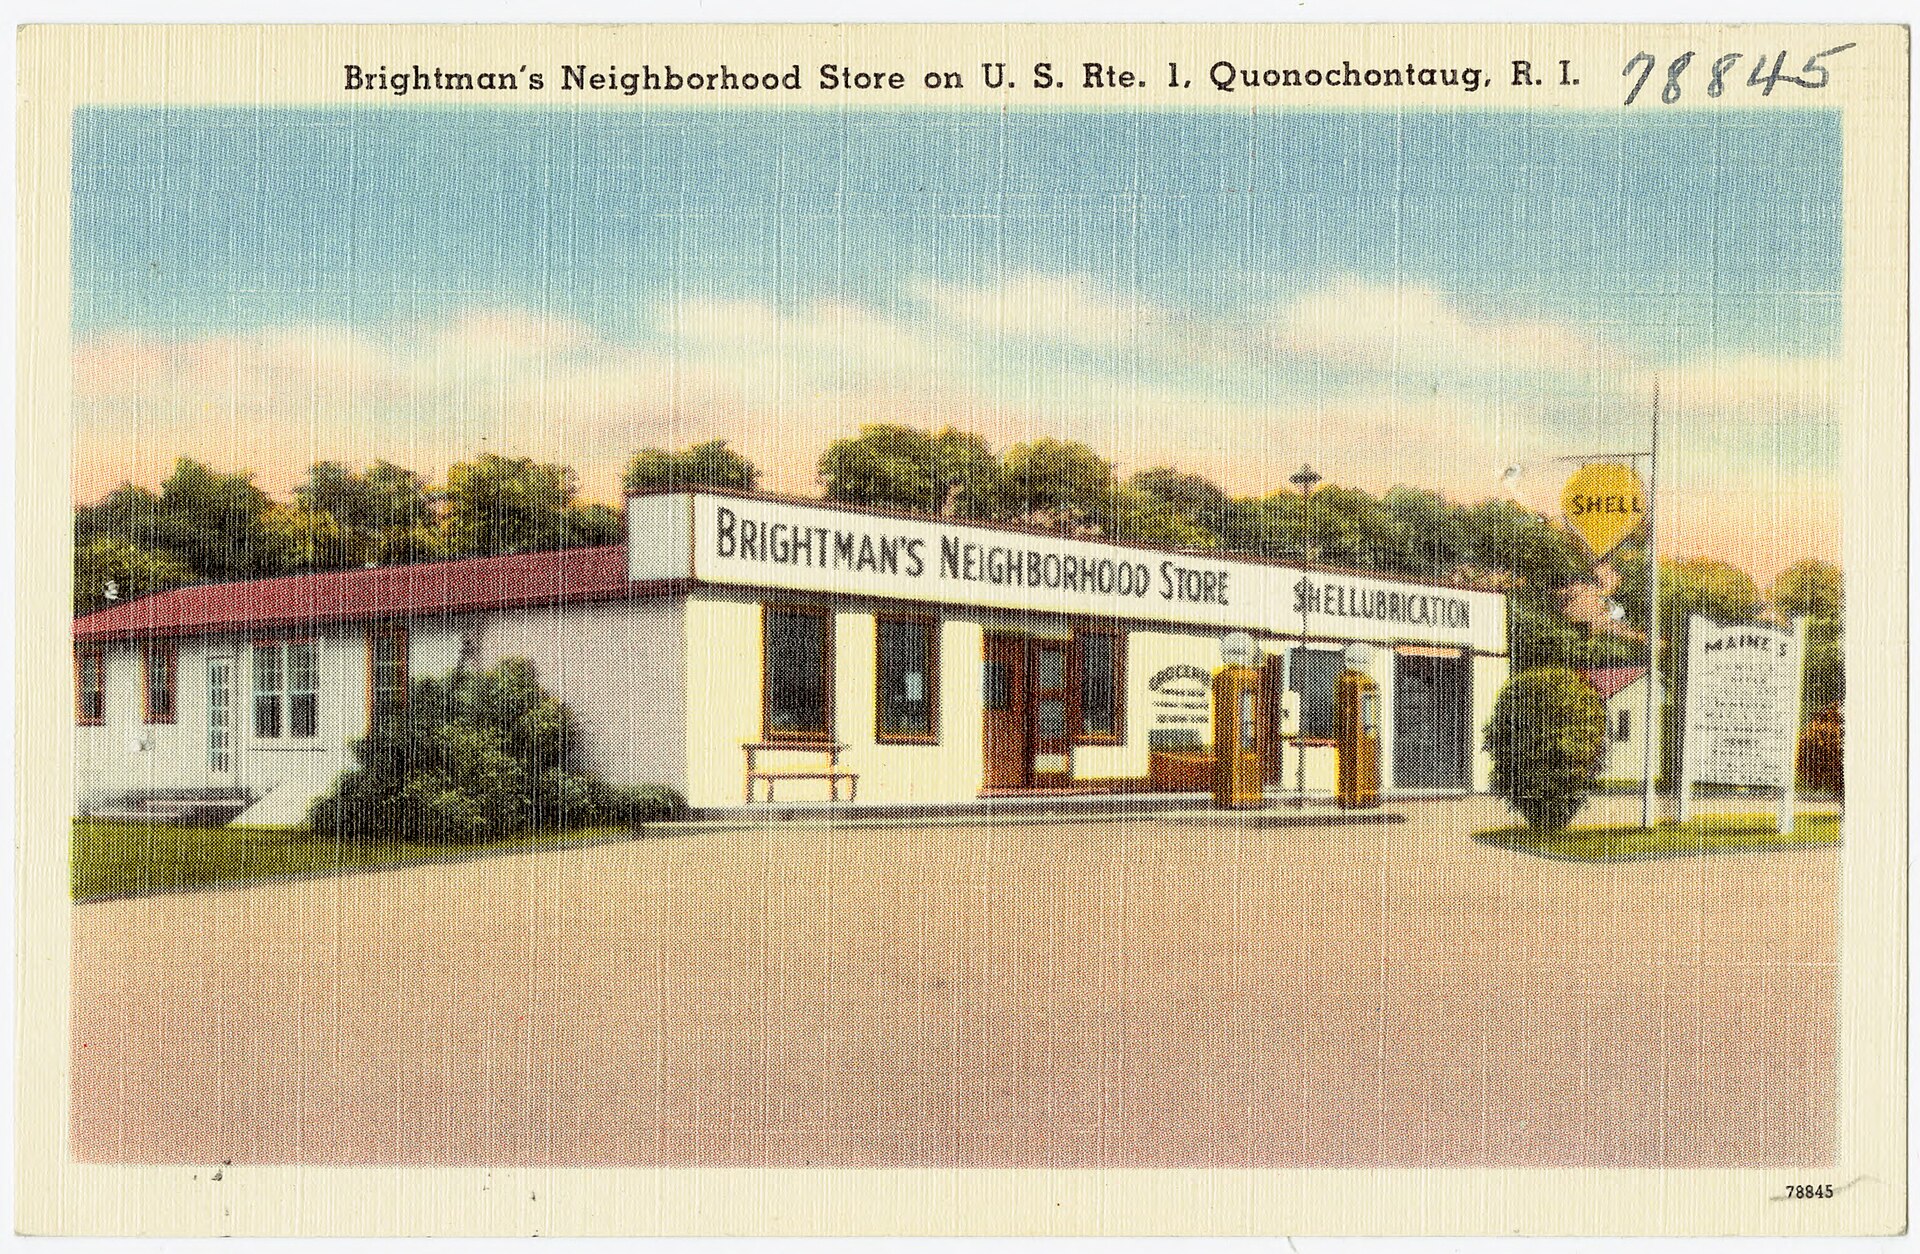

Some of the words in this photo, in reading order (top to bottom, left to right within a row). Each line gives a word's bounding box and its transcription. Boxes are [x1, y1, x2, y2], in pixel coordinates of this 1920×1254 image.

[1622, 42, 1857, 106] 78845
[1571, 493, 1642, 516] SHELL
[715, 506, 926, 577] BRIGHTMAN'S
[940, 534, 1150, 598] NEIGHBORHOOD
[1159, 560, 1230, 606] STORE
[1293, 578, 1470, 629] SHELLUBRICATION
